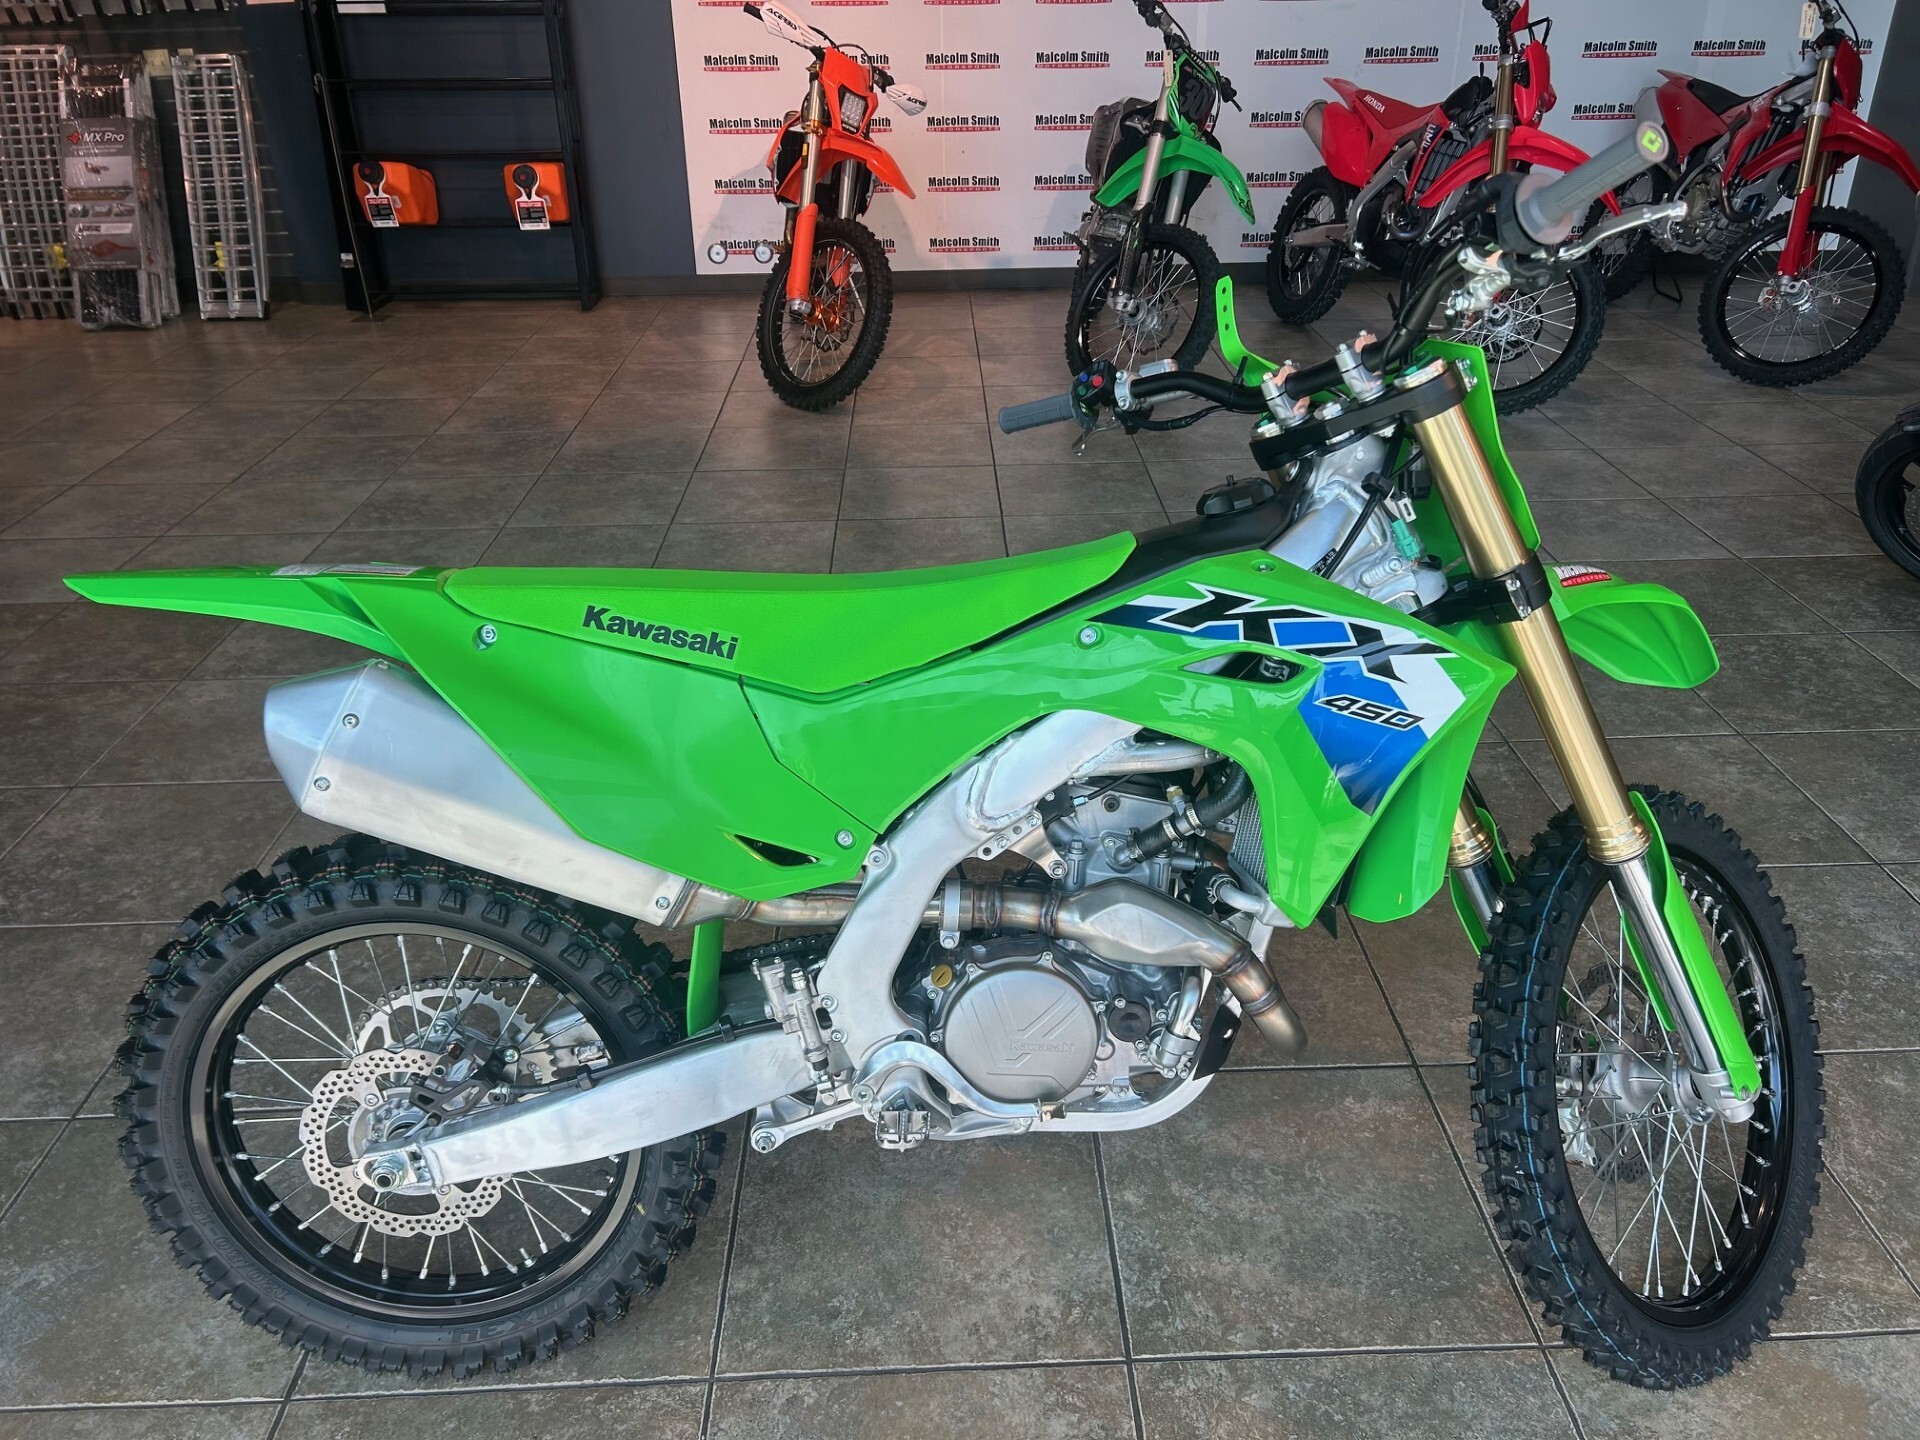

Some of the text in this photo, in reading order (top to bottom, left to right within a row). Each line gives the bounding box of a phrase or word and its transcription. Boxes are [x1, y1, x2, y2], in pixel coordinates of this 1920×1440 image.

[1474, 44, 1500, 55] Malc
[1584, 40, 1658, 52] Malcolm Smith
[1693, 39, 1766, 51] Malcolm Smith
[1036, 51, 1110, 63] Malcolm Smith
[1197, 50, 1220, 61] mith
[1256, 48, 1329, 60] Malcolm Smith
[1365, 45, 1439, 58] Malcolm Smith
[703, 54, 779, 66] Malcolm Smith
[926, 52, 1000, 64] Malcolm Smith
[1363, 94, 1386, 114] HONDA
[1573, 103, 1616, 115] Malcolm
[709, 117, 783, 129] Malcolm Smith
[869, 117, 891, 128] mith
[927, 115, 1000, 127] Malcolm Smith
[1035, 114, 1077, 125] Malcolm
[1251, 111, 1292, 123] Malcolm
[83, 132, 125, 142] MX Pro
[928, 176, 1000, 187] Malcolm Smith
[1034, 175, 1076, 186] Malcolm
[1246, 171, 1287, 183] Malcolm
[714, 179, 757, 190] Malcolm
[929, 237, 1000, 248] Malcolm Smith
[582, 604, 739, 661] Kawasaki
[1320, 693, 1425, 731] 450
